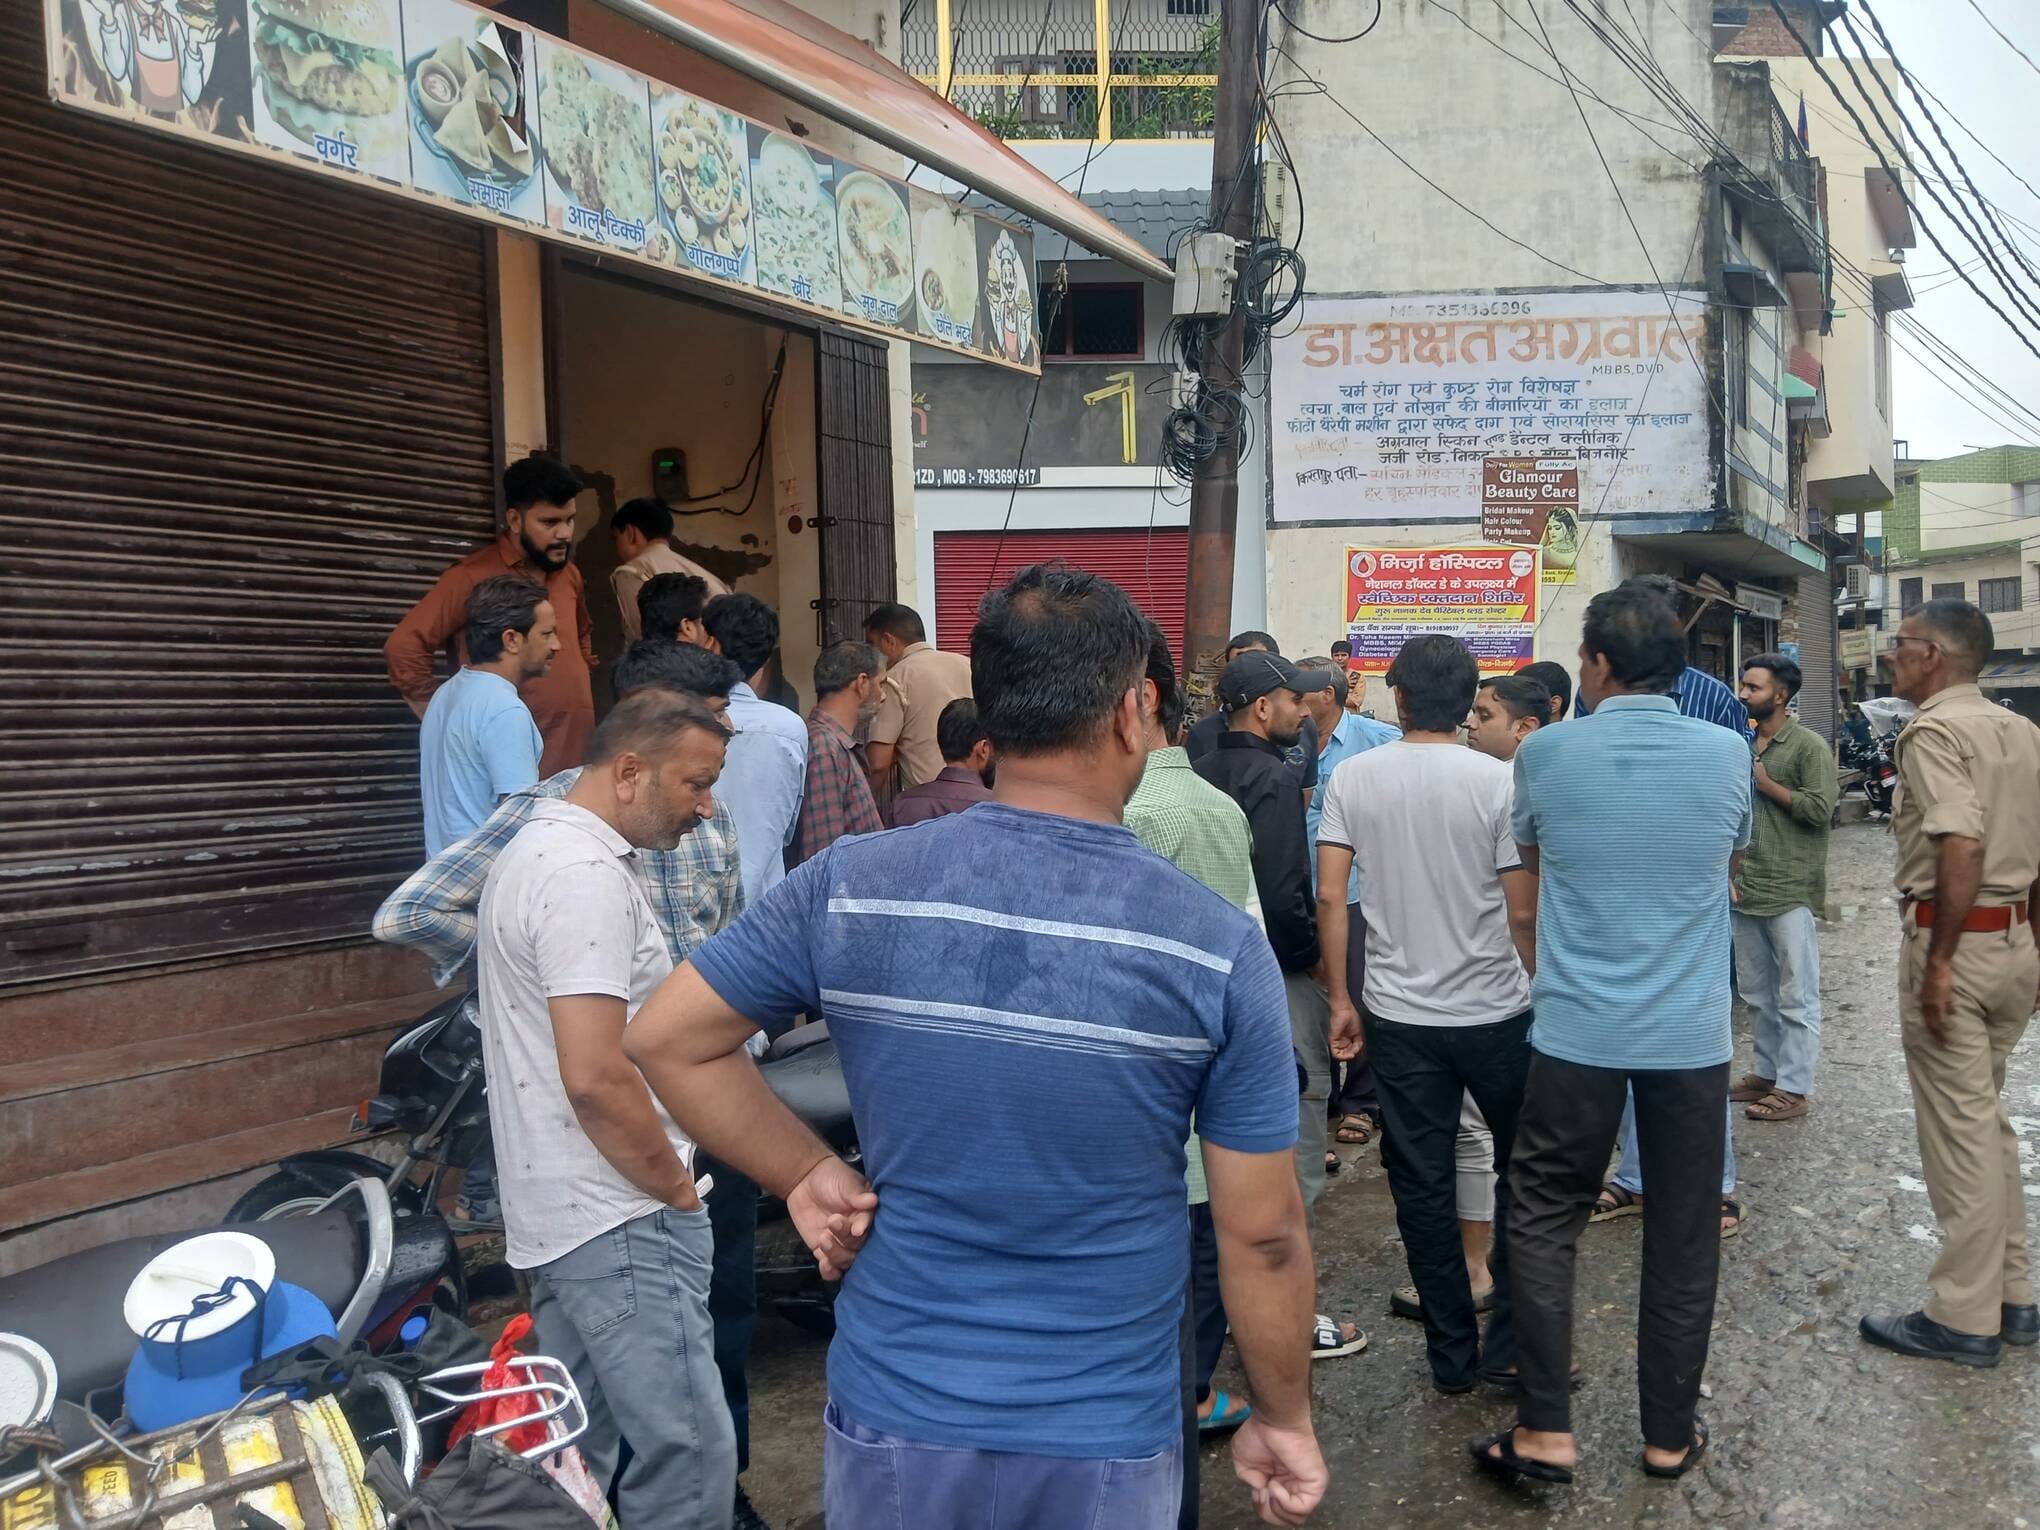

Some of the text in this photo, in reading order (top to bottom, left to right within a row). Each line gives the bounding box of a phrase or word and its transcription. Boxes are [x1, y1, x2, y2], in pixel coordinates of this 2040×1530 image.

[568, 206, 646, 245] आलू टिक्की
[791, 274, 812, 300] खीर
[1339, 376, 1581, 401] चर्म रोग एवं कुष्ठ रोग विशेषज्ञ
[1372, 400, 1399, 417] एवं
[1457, 396, 1480, 412] की
[1485, 396, 1552, 413] बीमारियों
[1558, 398, 1583, 411] का
[1588, 397, 1633, 411] इलाज
[1355, 415, 1391, 433] मशीन
[1396, 418, 1427, 435] द्वारा
[1474, 416, 1504, 432] दाग
[1509, 413, 1537, 431] एवं
[1650, 412, 1693, 428] इलाज
[1376, 436, 1432, 449] अग्रवाल
[1437, 432, 1480, 449] स्किन
[1558, 428, 1623, 446] क्लीनिक
[1378, 448, 1410, 464] जजी
[943, 469, 966, 484] MOB
[977, 468, 1037, 484] 7983690617
[1500, 469, 1563, 483] Glamour
[1485, 484, 1538, 500] Beauty
[1541, 484, 1577, 498] Care
[1507, 507, 1534, 516] Makeup
[1500, 517, 1523, 525] Colour
[1484, 528, 1531, 537] Party Makeup
[1429, 553, 1505, 570] हॉस्पिटल
[1365, 577, 1403, 590] नेशनल
[1405, 577, 1437, 590] डॉक्टर
[1439, 577, 1448, 589] डे
[1450, 577, 1461, 589] के
[1506, 577, 1518, 589] में
[1482, 590, 1525, 604] शिविर
